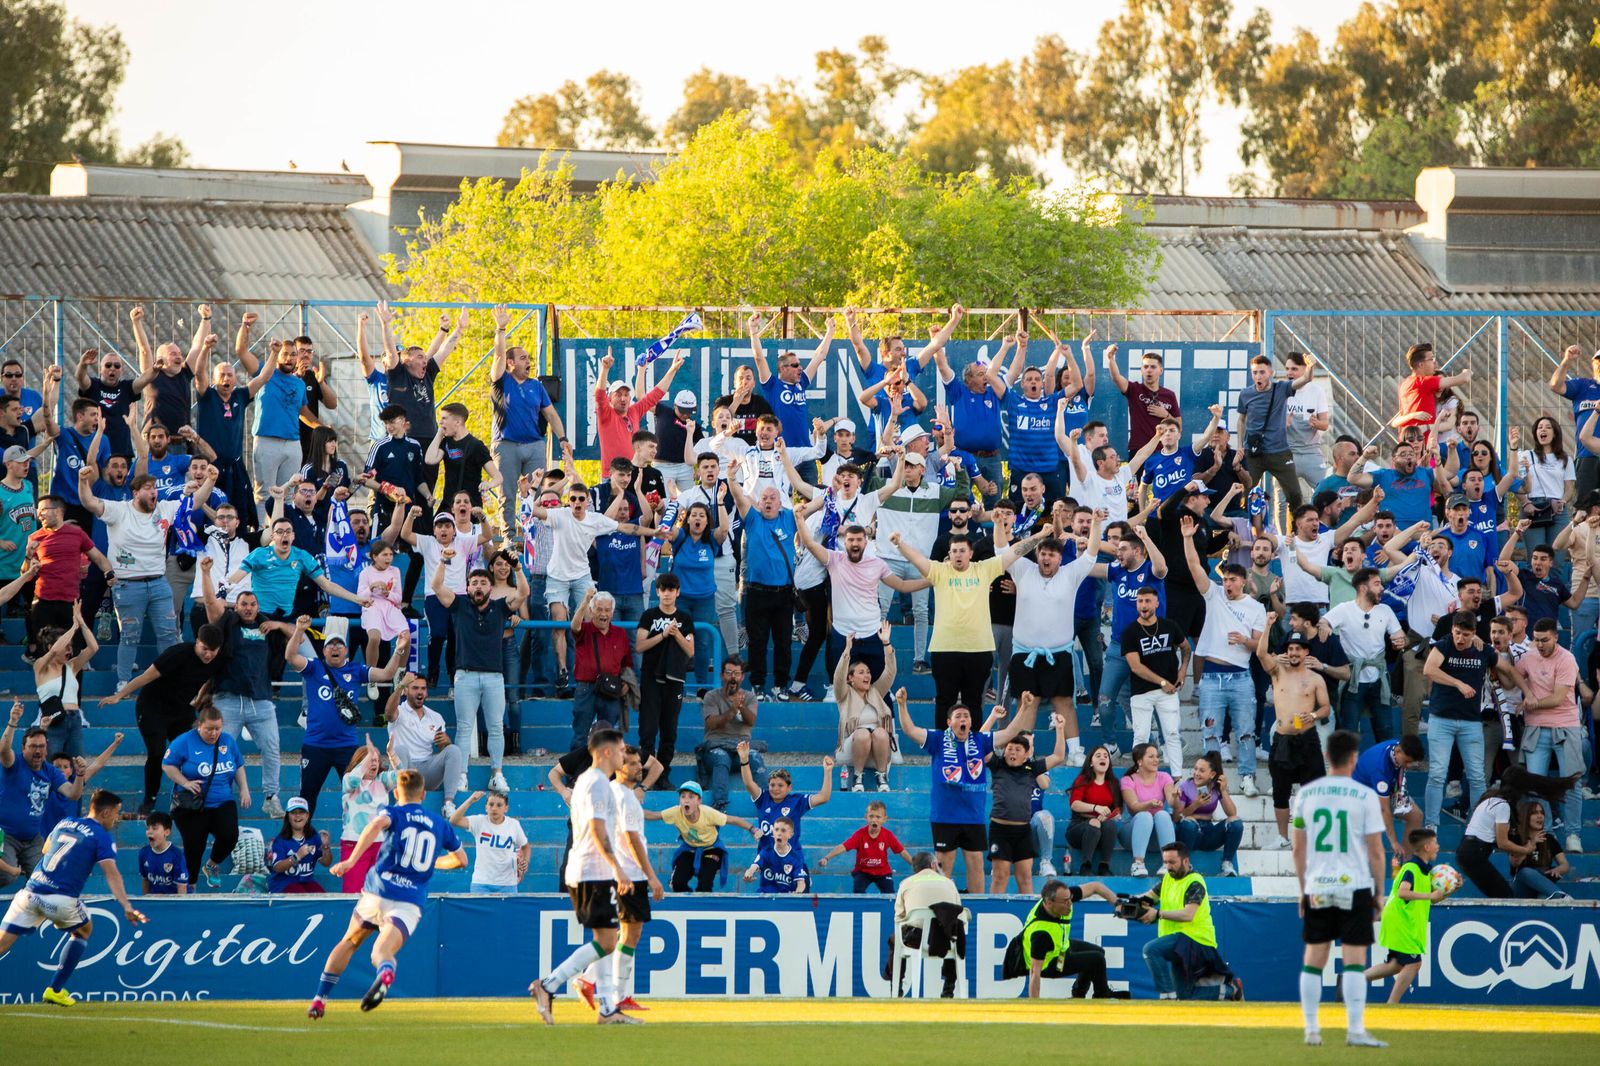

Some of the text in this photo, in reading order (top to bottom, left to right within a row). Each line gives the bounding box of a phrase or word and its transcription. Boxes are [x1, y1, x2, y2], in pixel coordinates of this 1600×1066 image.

[1168, 469, 1187, 482] MLC
[1140, 633, 1170, 651] EA7
[1448, 656, 1482, 666] HOLLISTER
[1313, 807, 1348, 854] 21
[479, 832, 513, 849] FILA
[44, 834, 77, 872] 7
[400, 827, 436, 873] 10
[774, 873, 792, 884] MLC
[37, 906, 325, 989] Digital
